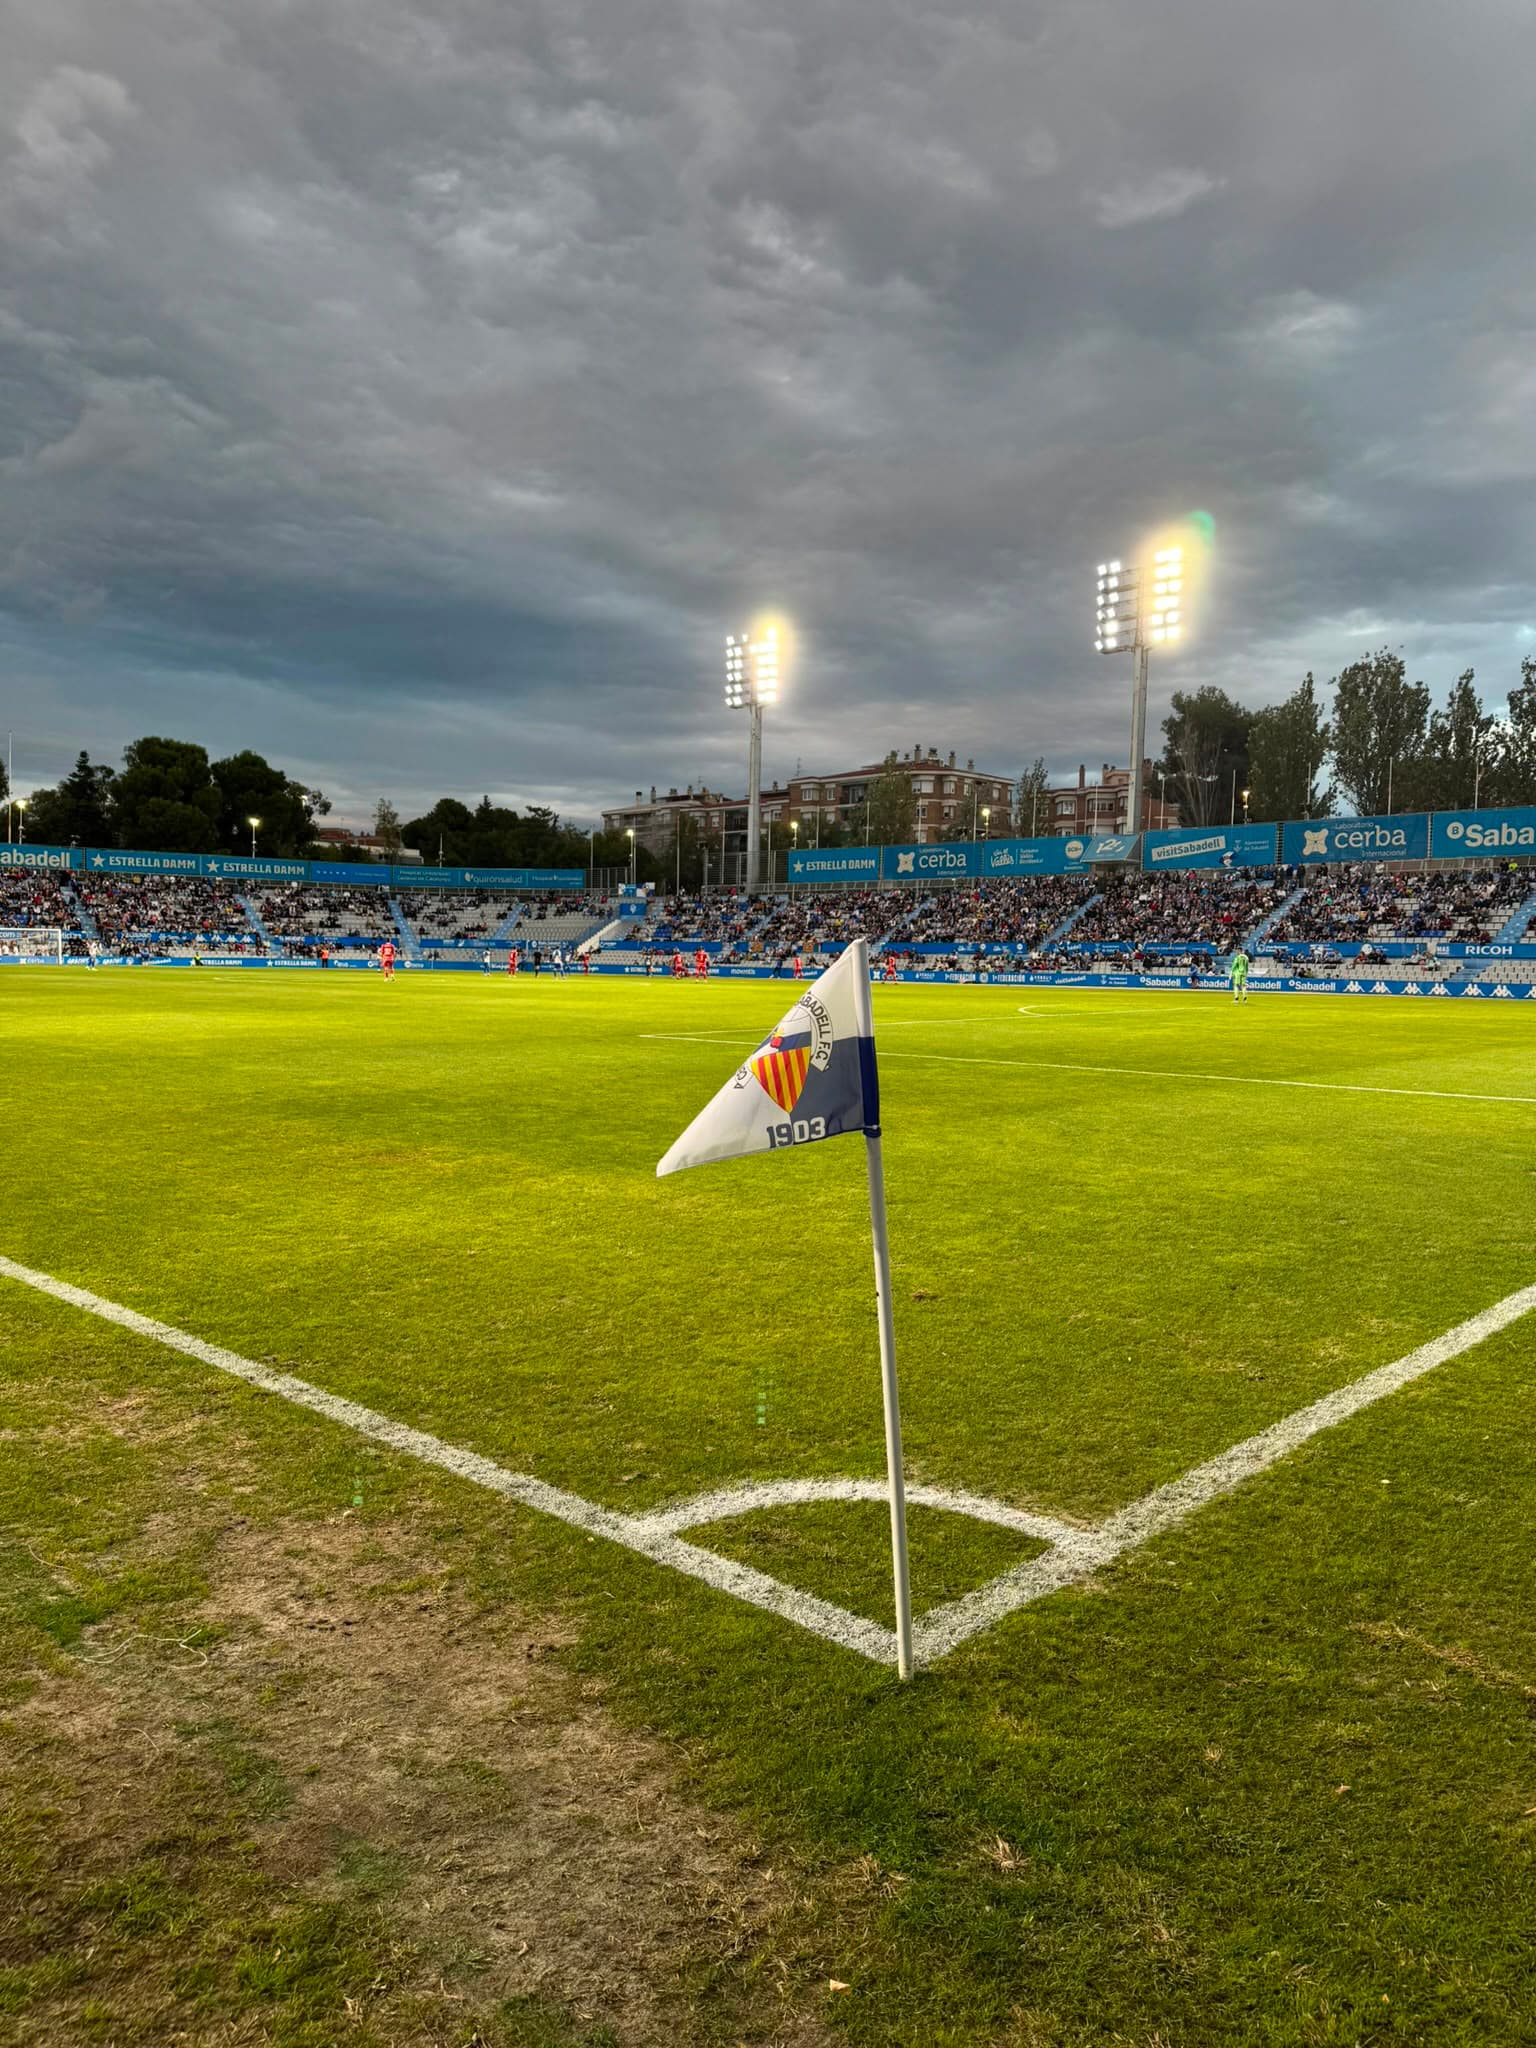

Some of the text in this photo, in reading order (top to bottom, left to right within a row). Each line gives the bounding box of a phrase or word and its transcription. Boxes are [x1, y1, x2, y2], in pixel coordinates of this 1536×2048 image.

[1334, 825, 1407, 849] cerba
[1156, 838, 1221, 858] visitSabadell
[1361, 848, 1407, 858] Internacional
[108, 855, 196, 869] ESTRELLA DAMM
[806, 859, 876, 872] ESTRELLA DAMM
[918, 850, 967, 869] cerba
[223, 862, 271, 874] ESTRELLA
[273, 865, 305, 876] DAMM
[1465, 945, 1513, 955] RICOH
[1145, 977, 1181, 987] Sabadell
[1295, 981, 1336, 992] Sabadell
[766, 1117, 826, 1149] 1903
